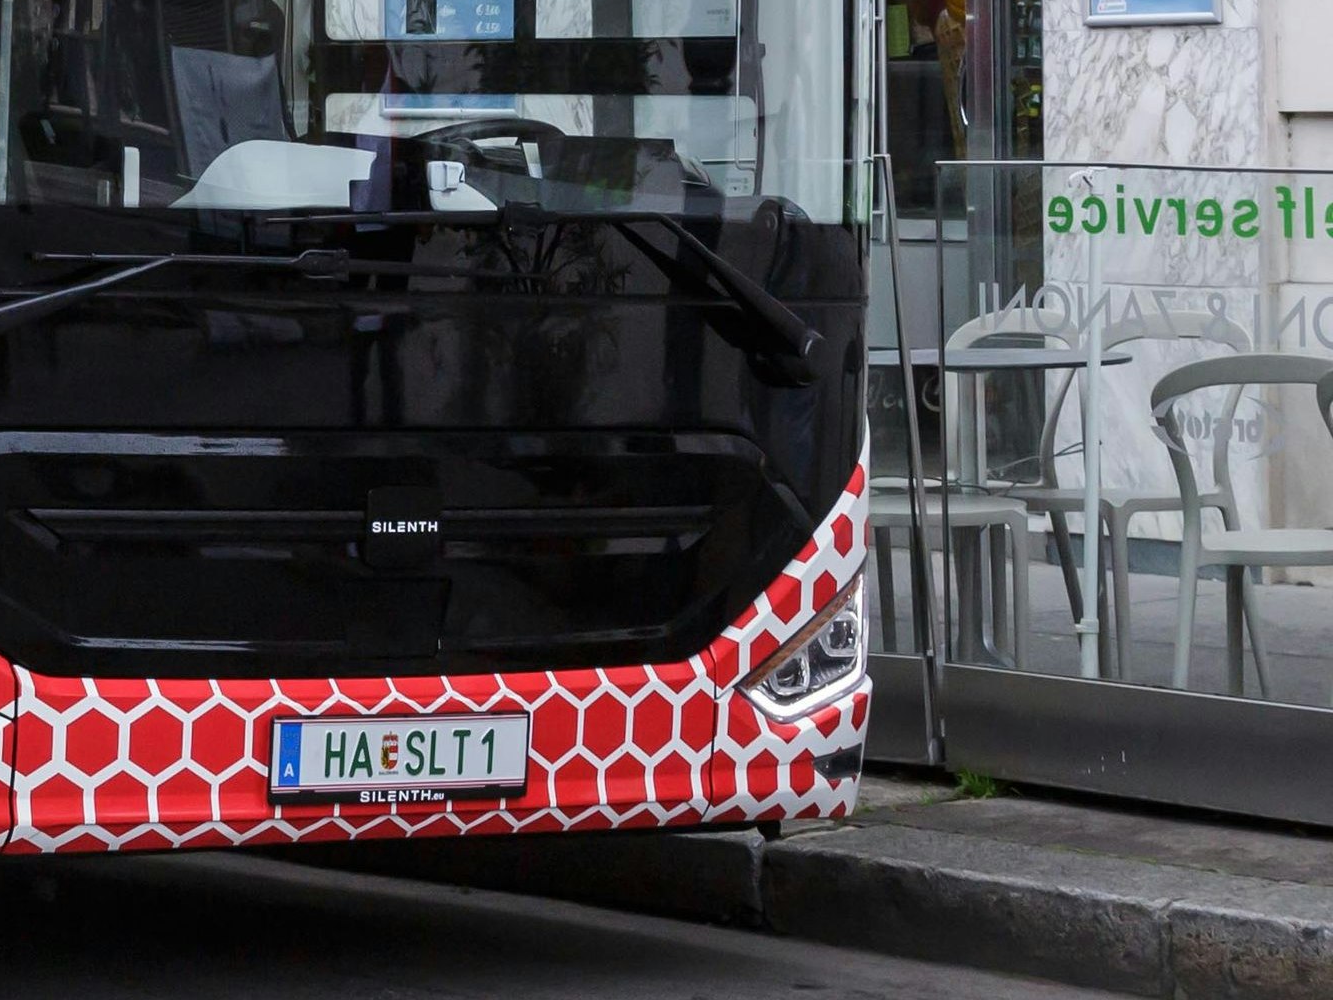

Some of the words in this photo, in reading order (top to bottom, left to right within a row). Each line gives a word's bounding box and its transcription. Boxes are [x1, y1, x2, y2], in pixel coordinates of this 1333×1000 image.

[372, 521, 438, 533] SILENTH
[324, 731, 373, 778] HA
[283, 763, 294, 777] A
[359, 789, 445, 803] SILENTH.eu
